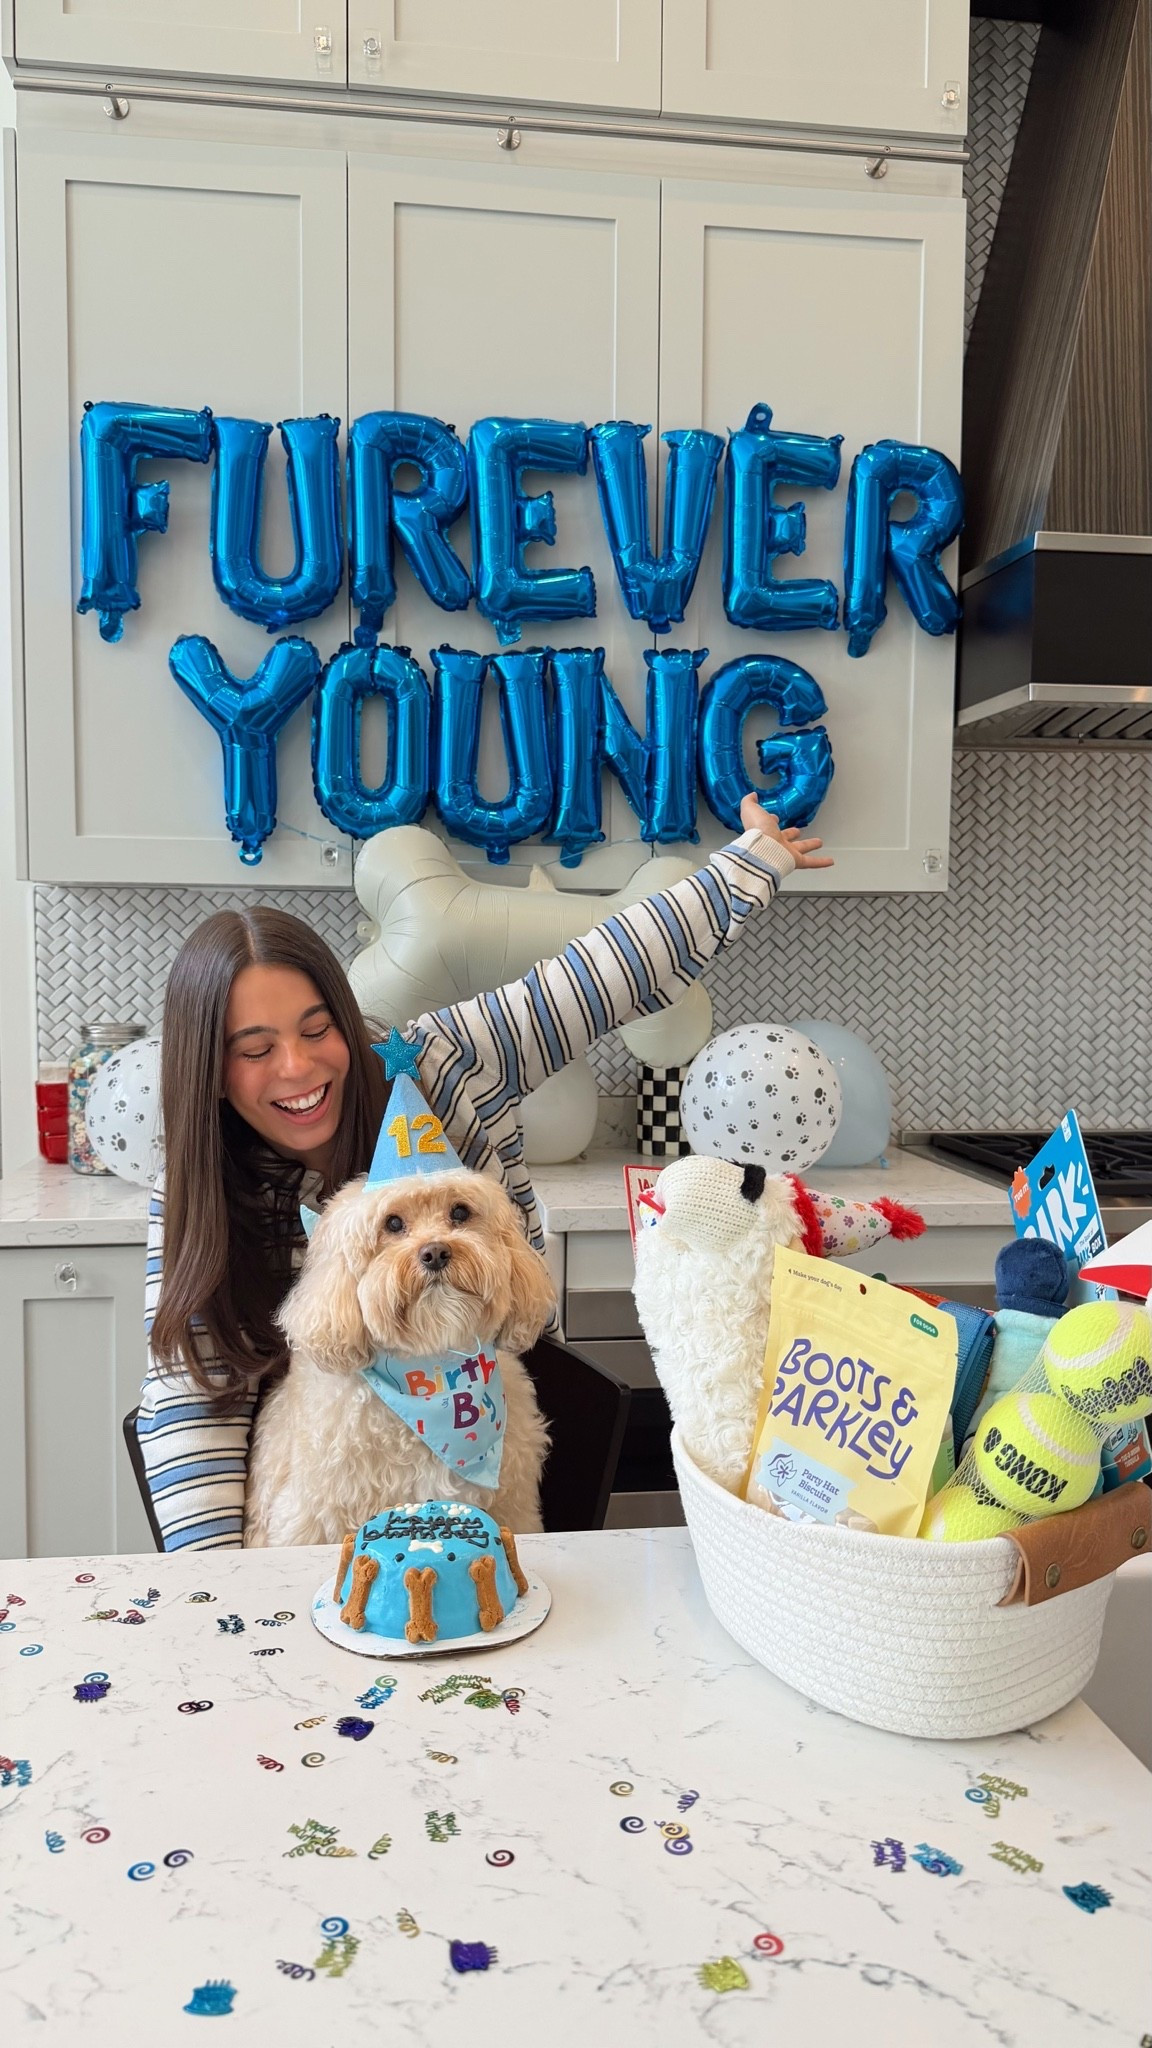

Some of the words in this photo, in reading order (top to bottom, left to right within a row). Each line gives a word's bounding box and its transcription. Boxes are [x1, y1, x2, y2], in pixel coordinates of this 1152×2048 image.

[78, 401, 965, 658] FUREVER
[168, 634, 834, 866] YOUNG
[387, 1113, 447, 1158] 12
[792, 1268, 807, 1280] Make
[807, 1274, 820, 1284] your
[779, 1338, 892, 1412] BOOTS
[891, 1387, 919, 1427] &
[453, 1391, 497, 1430] By
[798, 1479, 832, 1504] Biscuits
[801, 1468, 825, 1488] Party
[823, 1478, 840, 1496] Hat
[994, 1442, 1069, 1504] KONG
[791, 1489, 810, 1503] VANILLA
